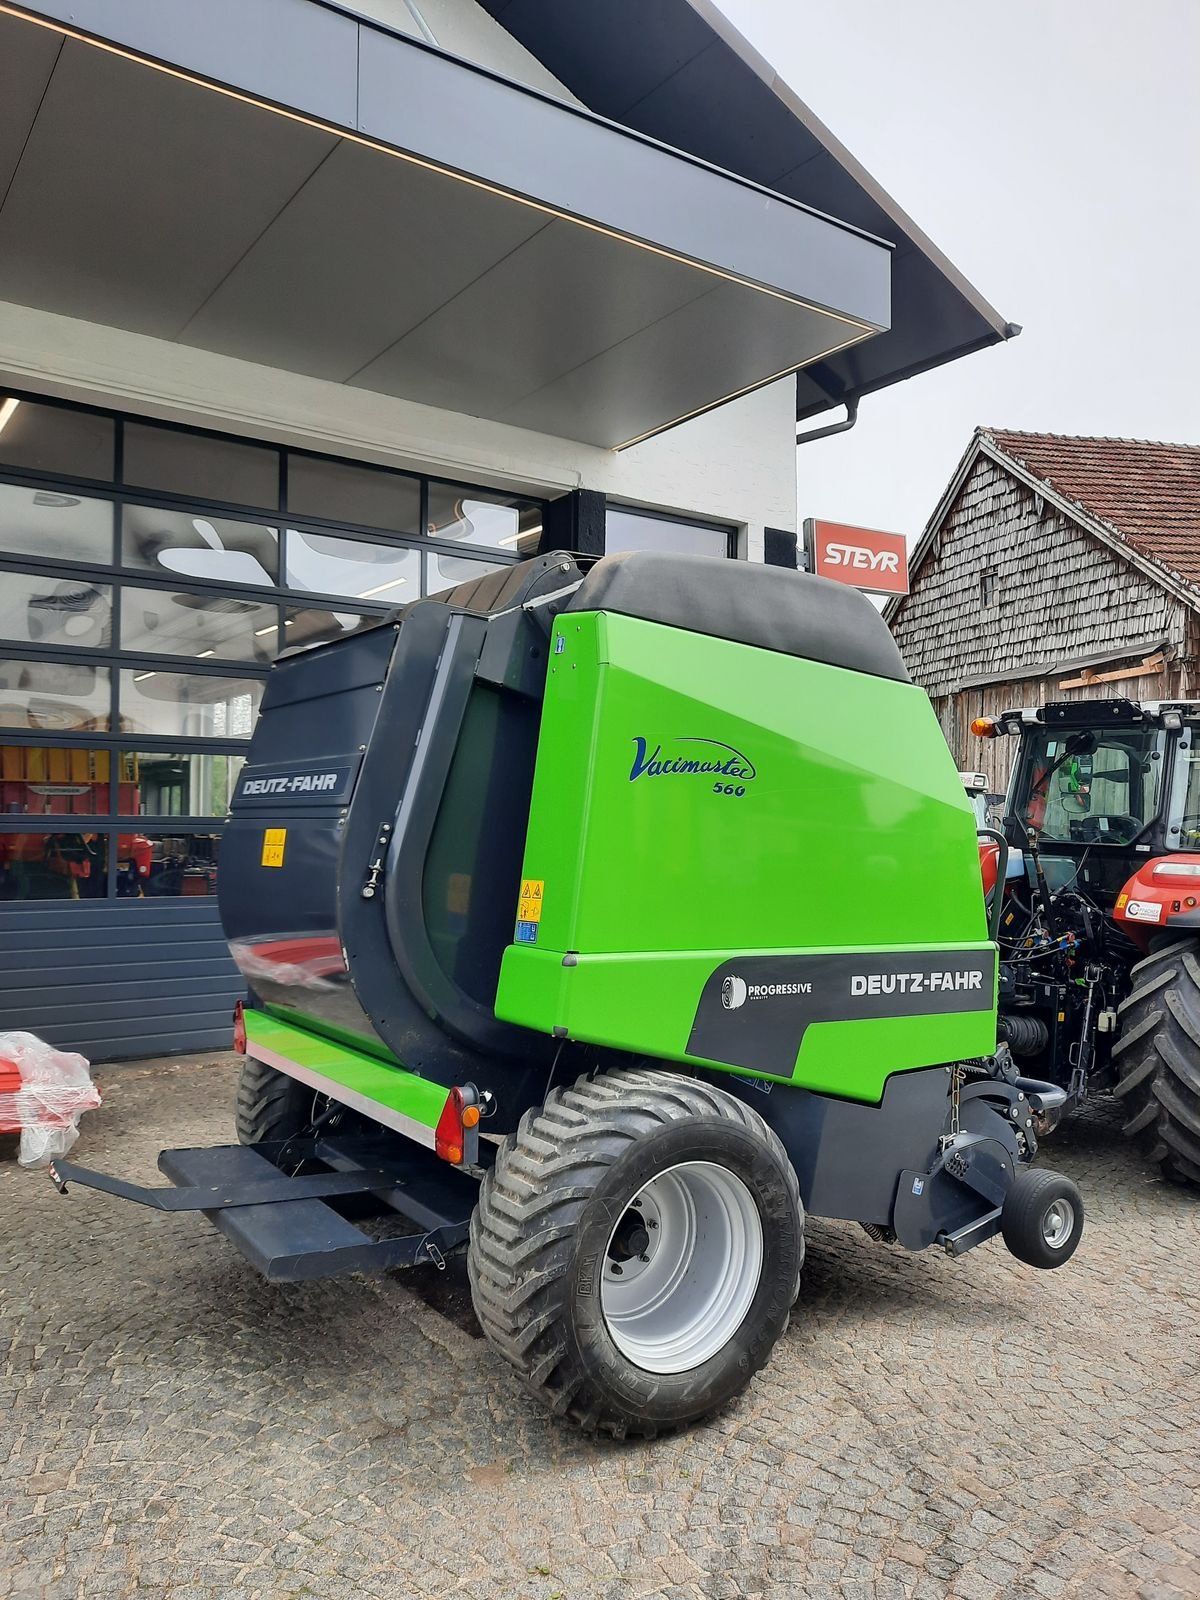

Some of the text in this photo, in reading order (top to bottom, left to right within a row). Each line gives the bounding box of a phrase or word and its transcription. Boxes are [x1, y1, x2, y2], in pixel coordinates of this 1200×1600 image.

[824, 542, 899, 573] STEYR
[629, 736, 756, 782] Varimaster
[242, 773, 338, 795] DEUTZ-FAHR
[713, 782, 746, 797] 560
[748, 983, 812, 996] PROGRESSIVE
[850, 970, 983, 996] DEUTZ-FAHR
